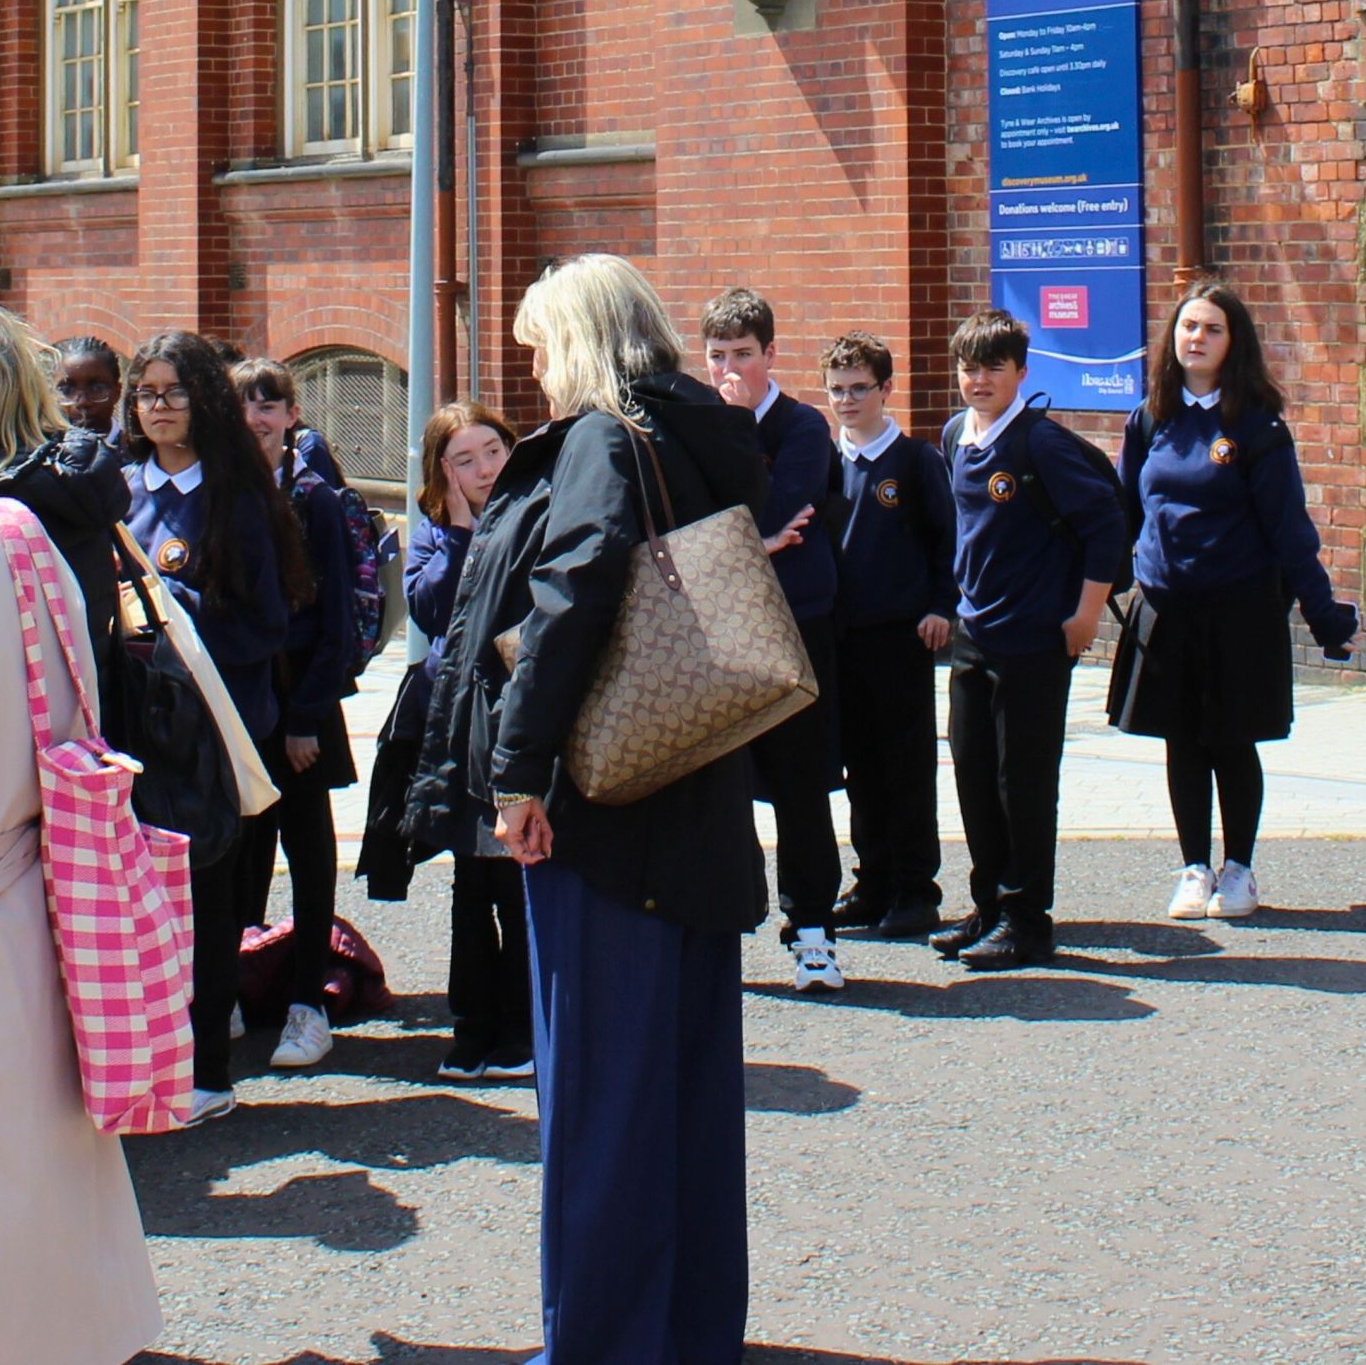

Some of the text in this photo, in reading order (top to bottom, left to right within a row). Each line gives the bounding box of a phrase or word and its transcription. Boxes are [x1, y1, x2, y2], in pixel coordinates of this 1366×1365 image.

[1017, 29, 1038, 37] Monday
[1040, 28, 1046, 36] to
[1047, 26, 1065, 34] Friday
[999, 48, 1024, 59] Saturday
[1025, 47, 1029, 56] &
[1030, 46, 1051, 56] Sunday
[1070, 43, 1084, 51] 4pm
[999, 68, 1027, 77] Discovery
[1041, 65, 1055, 74] open
[1056, 63, 1069, 72] until
[1092, 59, 1106, 69] daily
[1022, 85, 1036, 94] Bank
[1037, 83, 1061, 92] Holidays
[1000, 119, 1014, 128] Tyne
[1015, 118, 1020, 127] &
[1021, 118, 1035, 126] Wear
[1037, 116, 1061, 125] Archives
[1068, 115, 1082, 123] open
[1083, 113, 1091, 123] by
[1001, 129, 1036, 138] appointment
[1037, 127, 1049, 136] only
[1001, 141, 1007, 149] to
[1008, 139, 1022, 148] book
[1023, 139, 1036, 148] your
[999, 198, 1128, 215] Donations welcome (Free entry)
